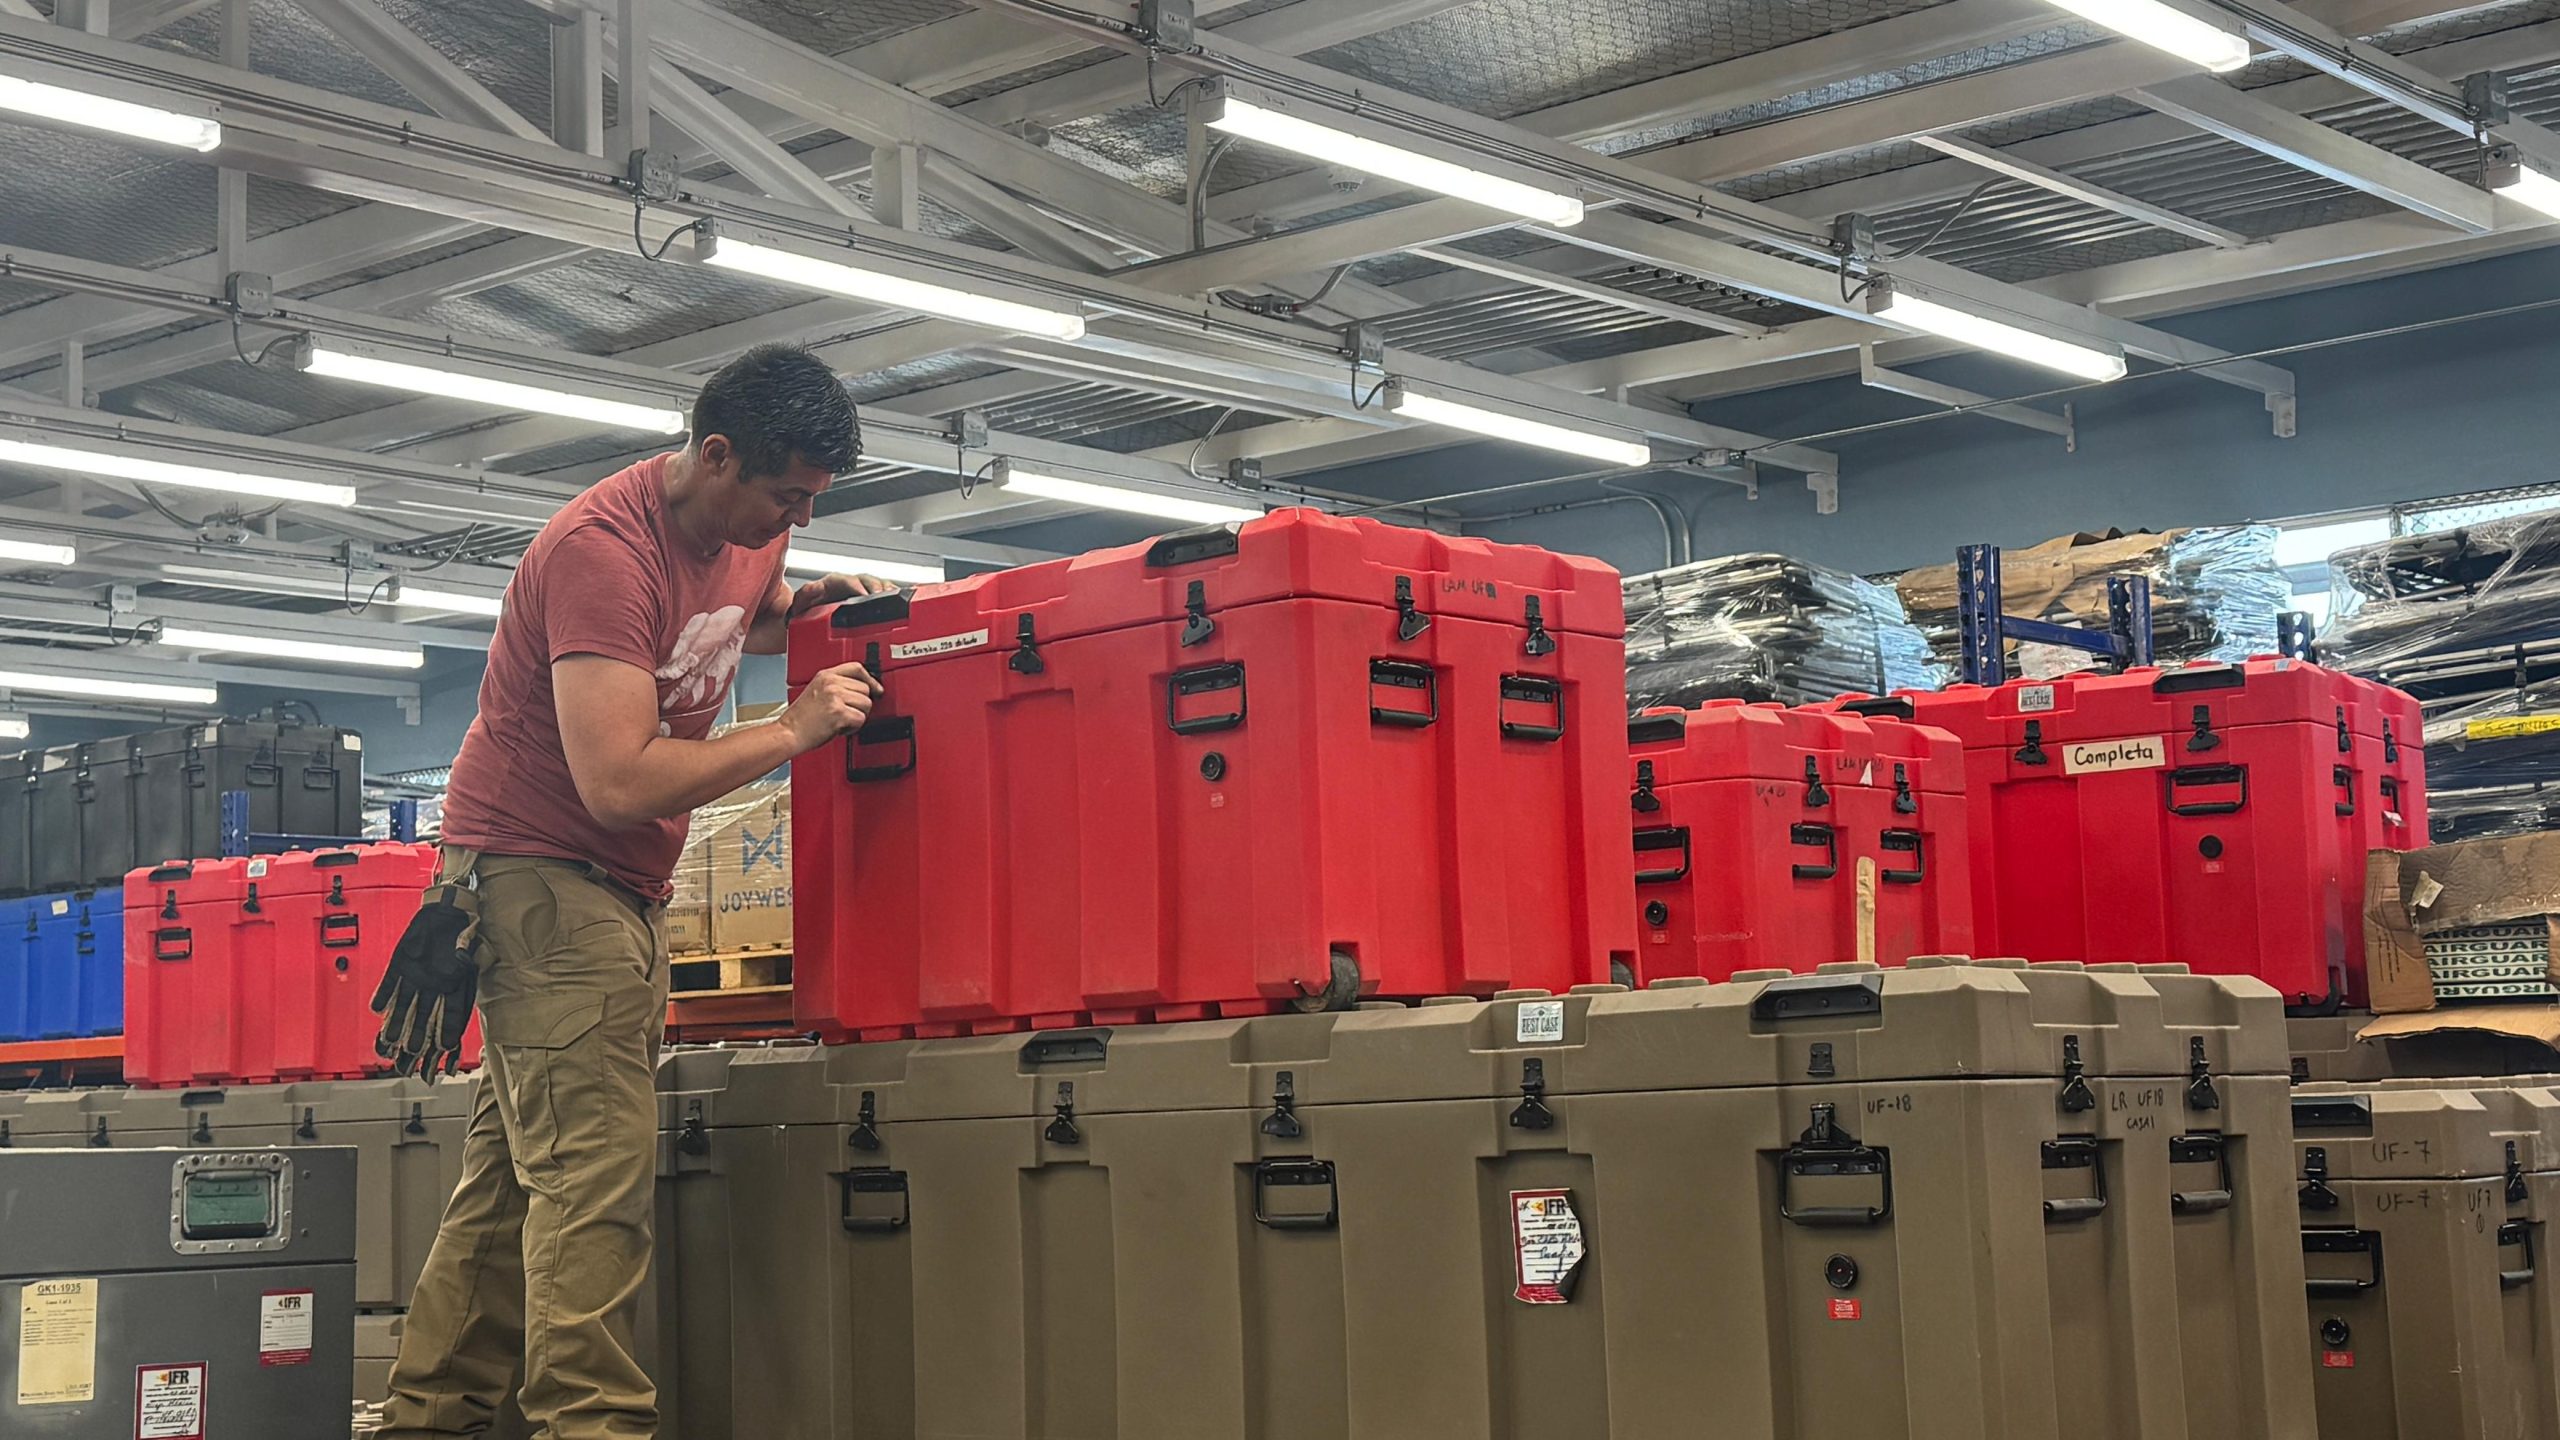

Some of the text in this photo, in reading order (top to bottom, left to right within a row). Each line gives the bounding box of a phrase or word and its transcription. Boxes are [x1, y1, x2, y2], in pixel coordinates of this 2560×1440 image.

[2075, 743, 2153, 767] Completa
[1867, 1094, 1912, 1114] UF-18
[2112, 1088, 2163, 1111] LR UF18
